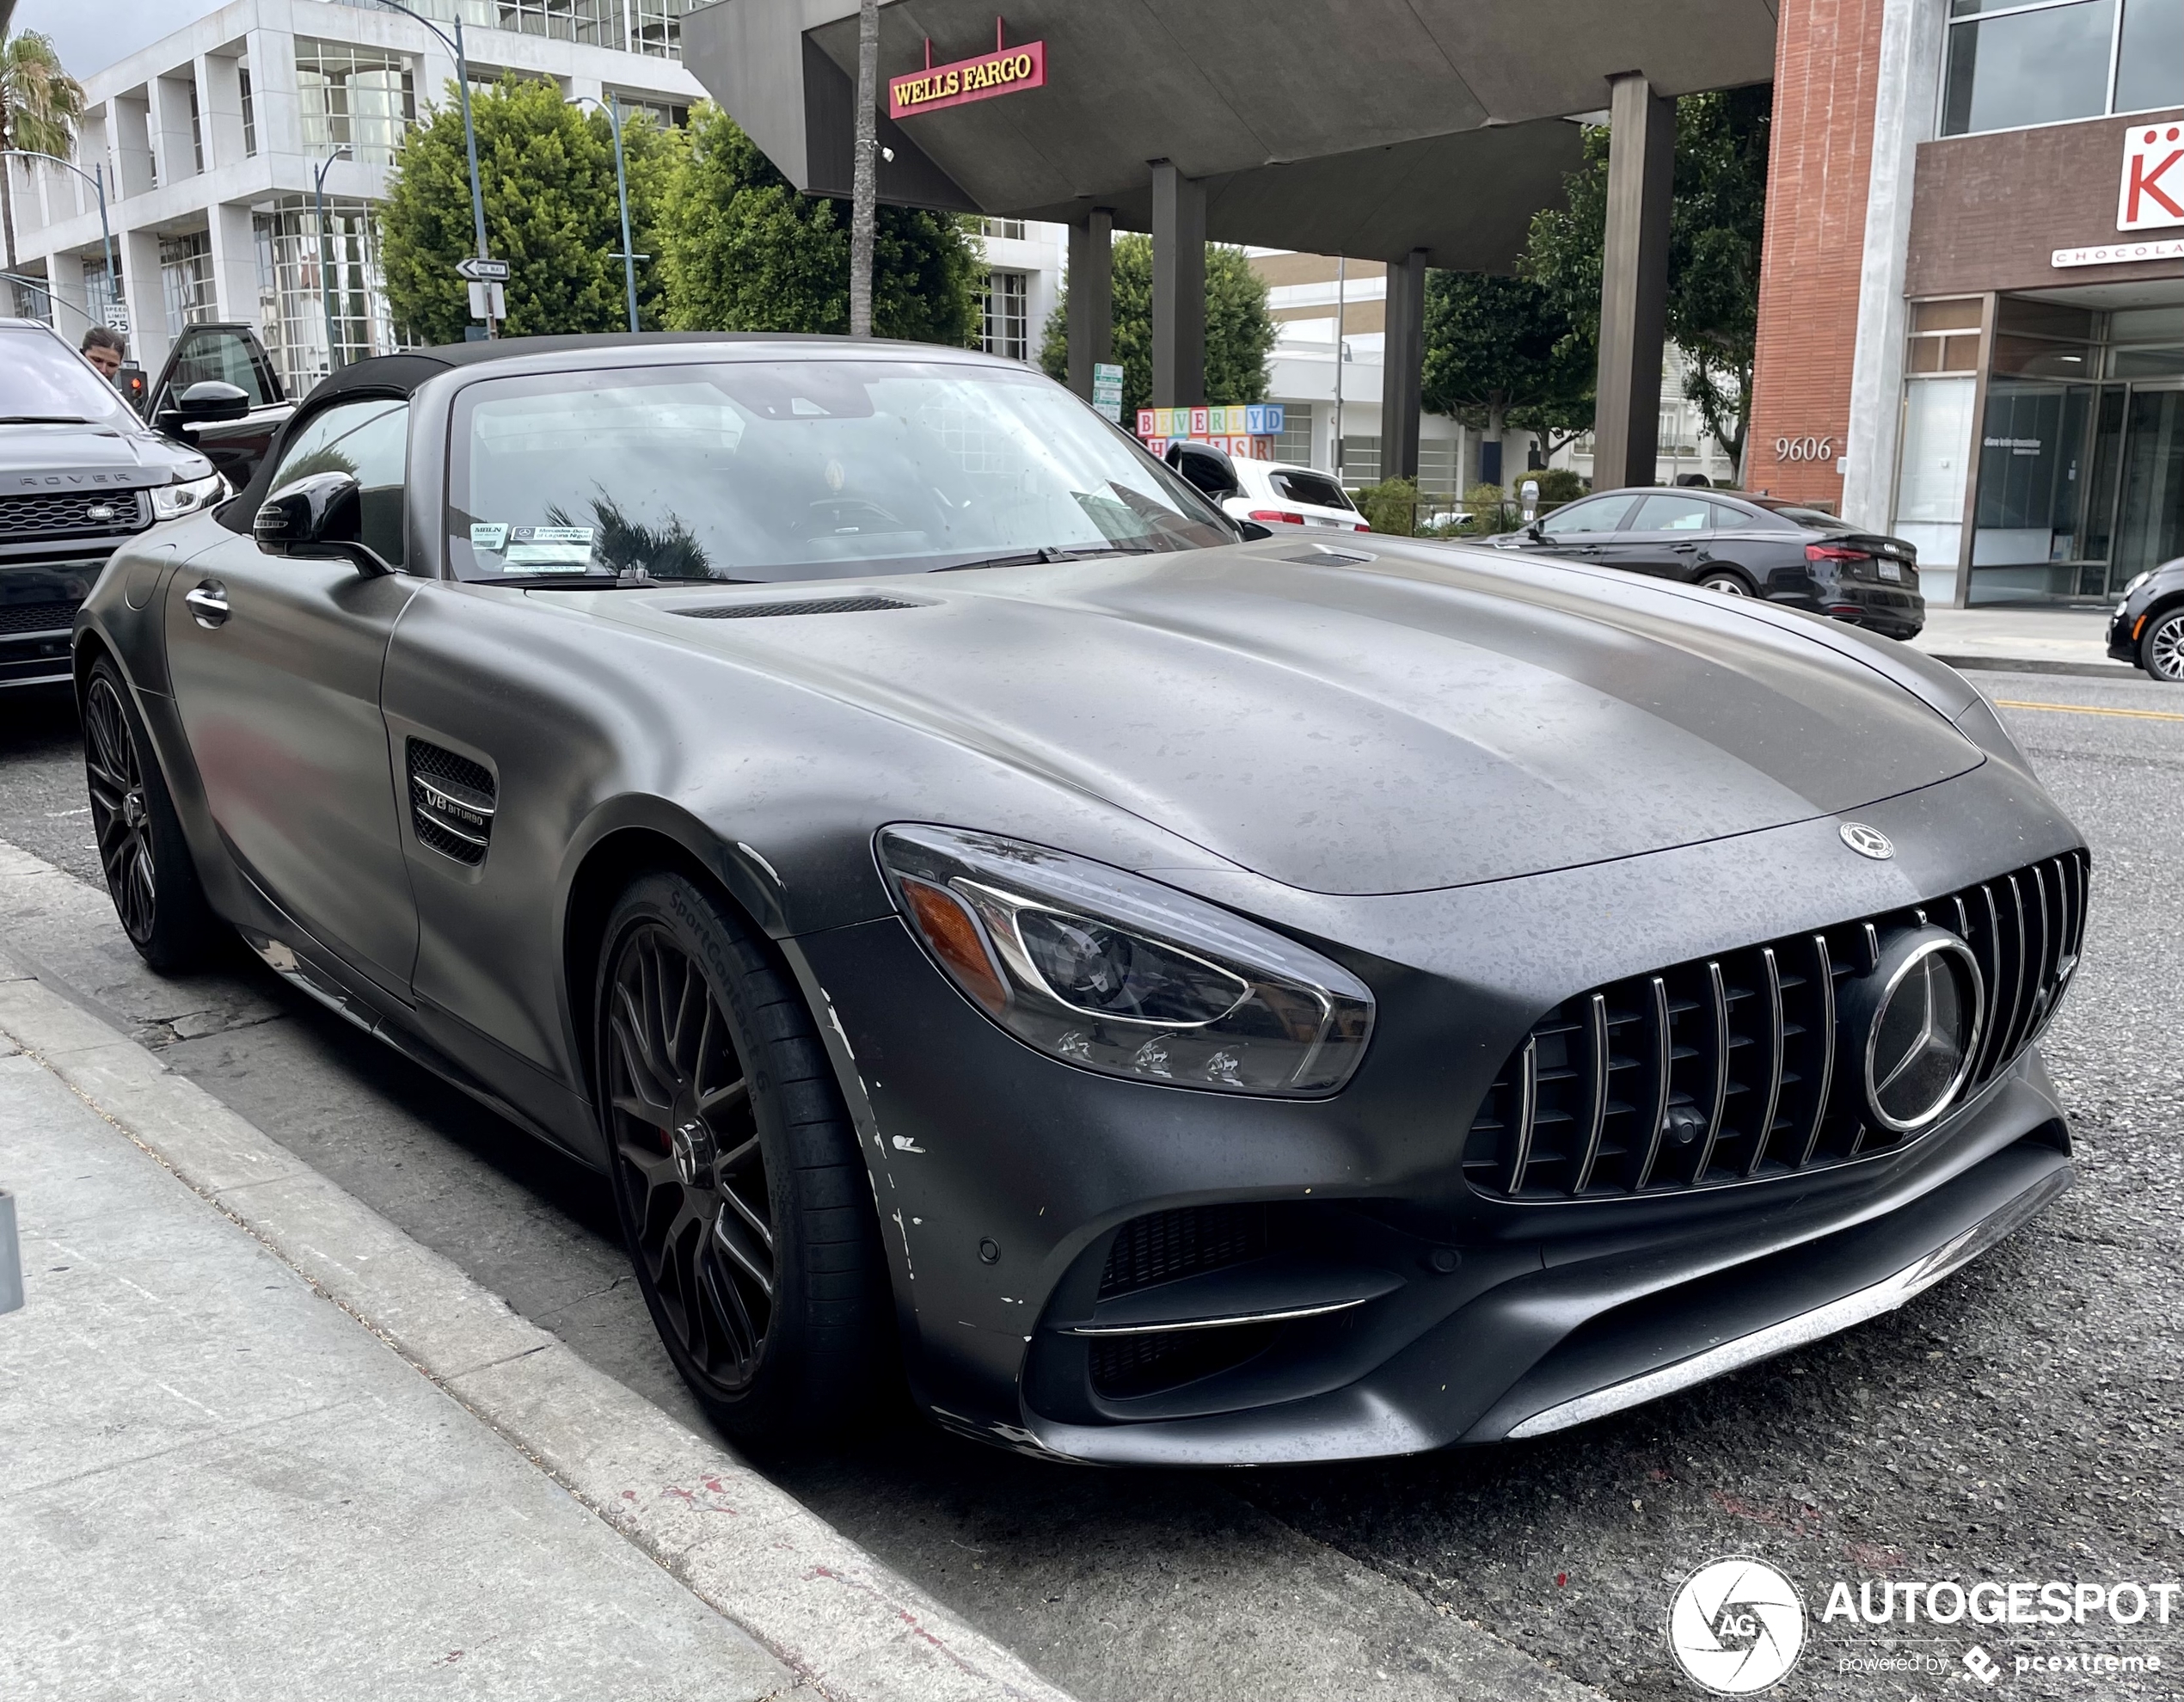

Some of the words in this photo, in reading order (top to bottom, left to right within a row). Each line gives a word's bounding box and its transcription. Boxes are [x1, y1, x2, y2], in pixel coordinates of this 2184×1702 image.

[893, 71, 960, 107] WELLS
[962, 53, 1032, 91] FARGO
[2056, 244, 2183, 262] CHOCOLA
[108, 320, 128, 332] 25
[1776, 435, 1832, 462] 9606
[20, 473, 132, 486] ROVER
[426, 790, 446, 810] V8
[448, 804, 483, 826] BITURBO
[669, 889, 760, 1060] SportContact
